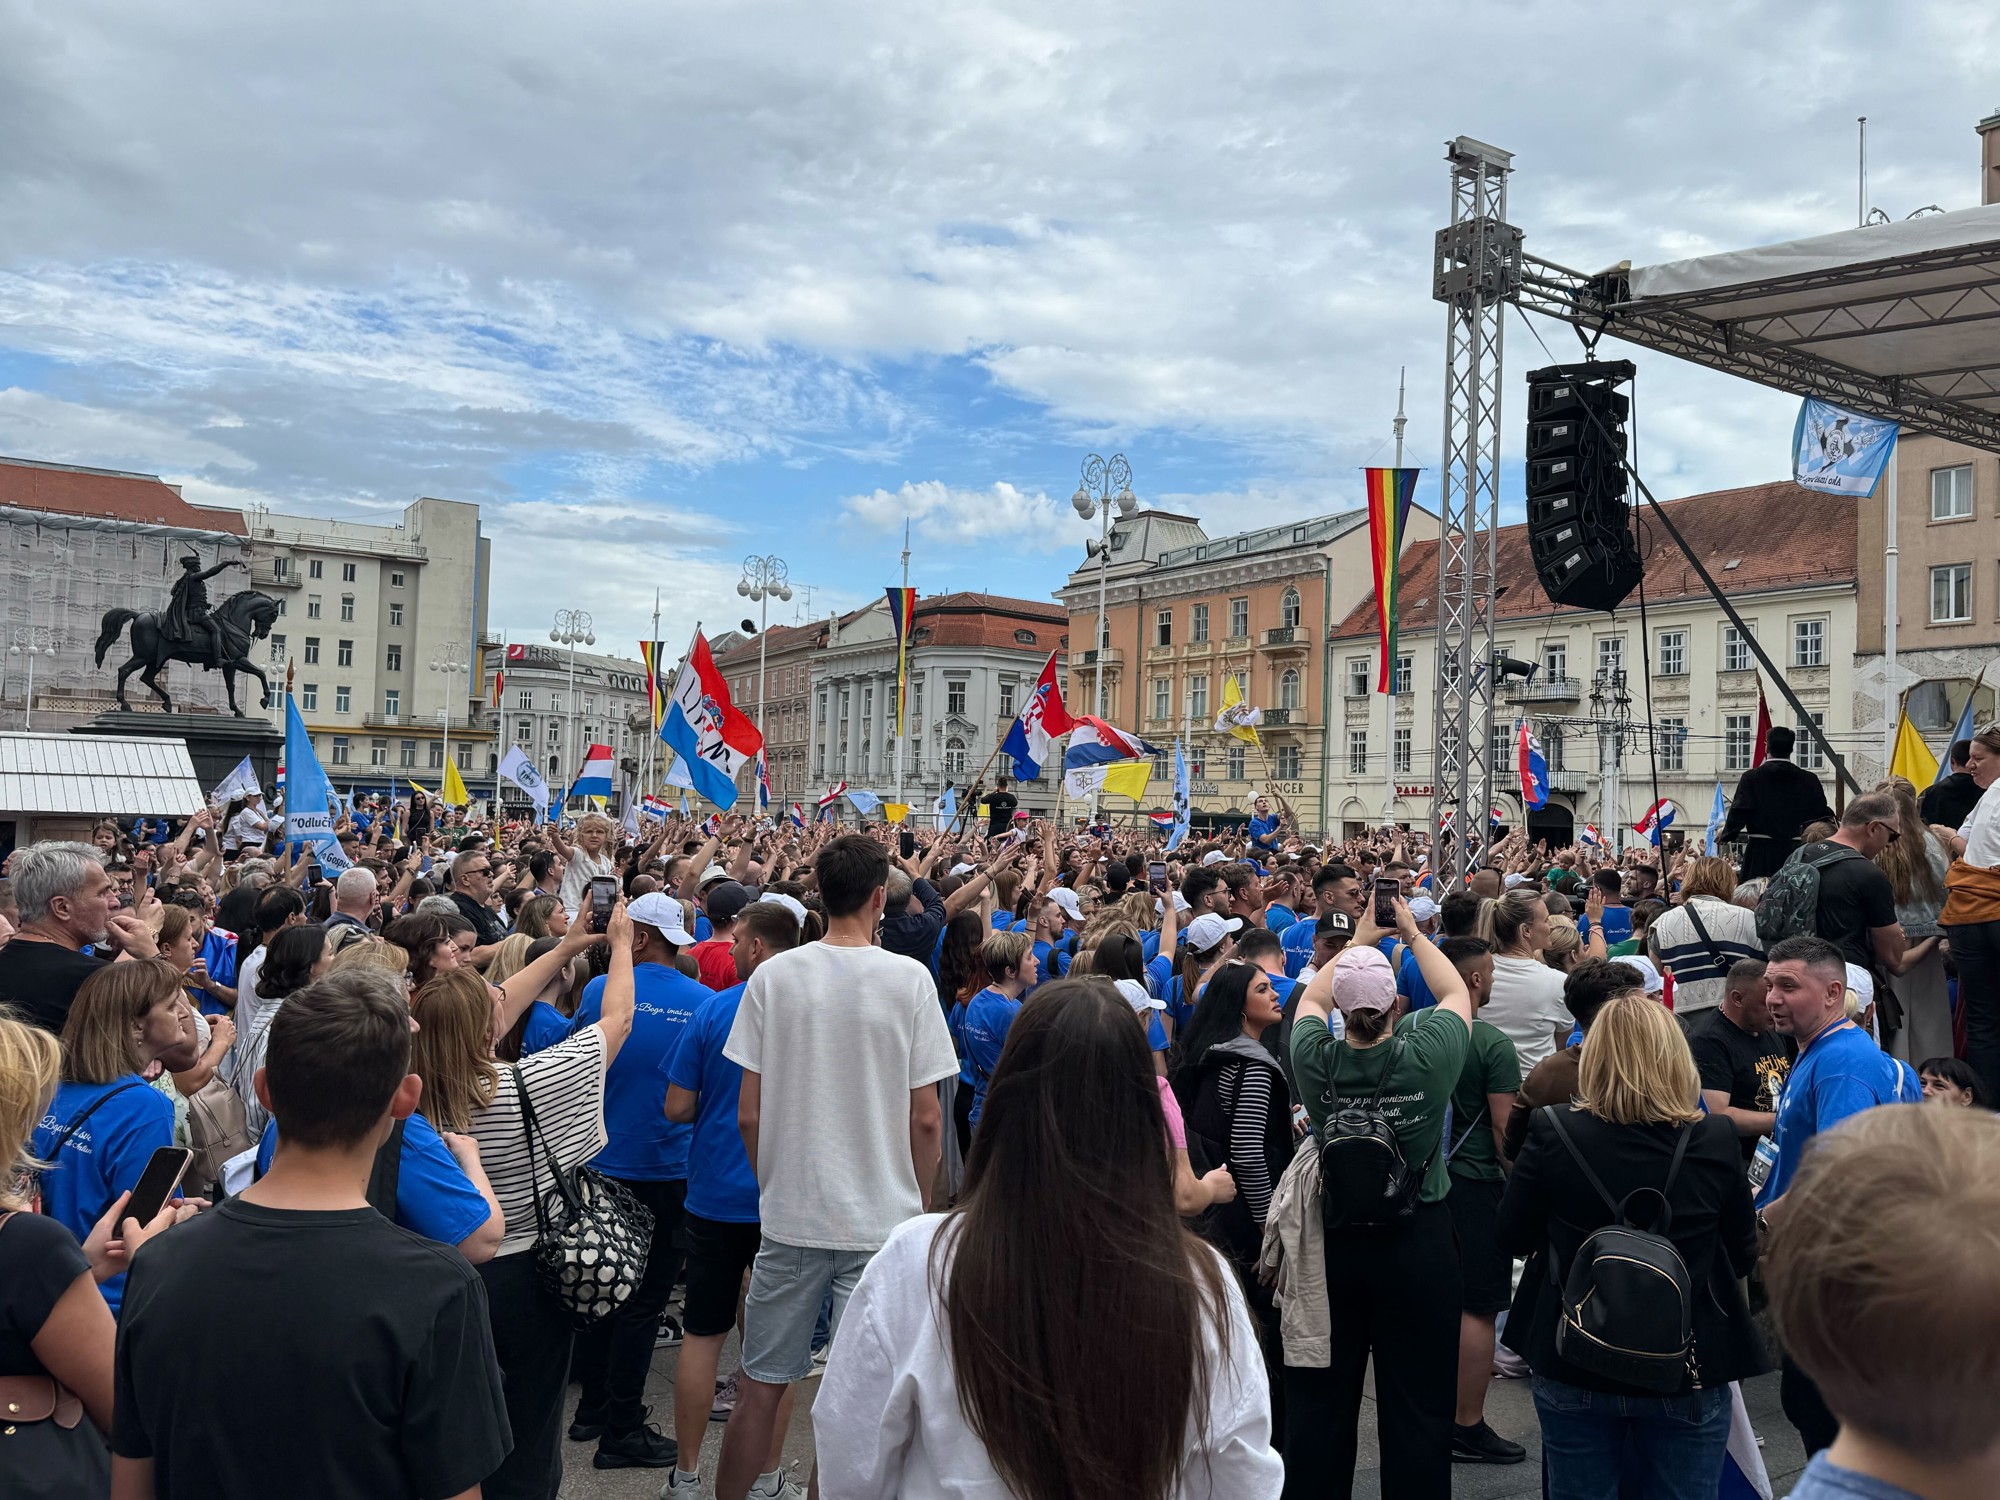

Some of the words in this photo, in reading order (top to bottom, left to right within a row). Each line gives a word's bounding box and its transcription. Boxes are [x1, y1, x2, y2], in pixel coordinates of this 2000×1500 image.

[1265, 782, 1304, 794] SNGER
[1321, 1090, 1351, 1104] Smo
[1378, 1091, 1425, 1107] poniznosti
